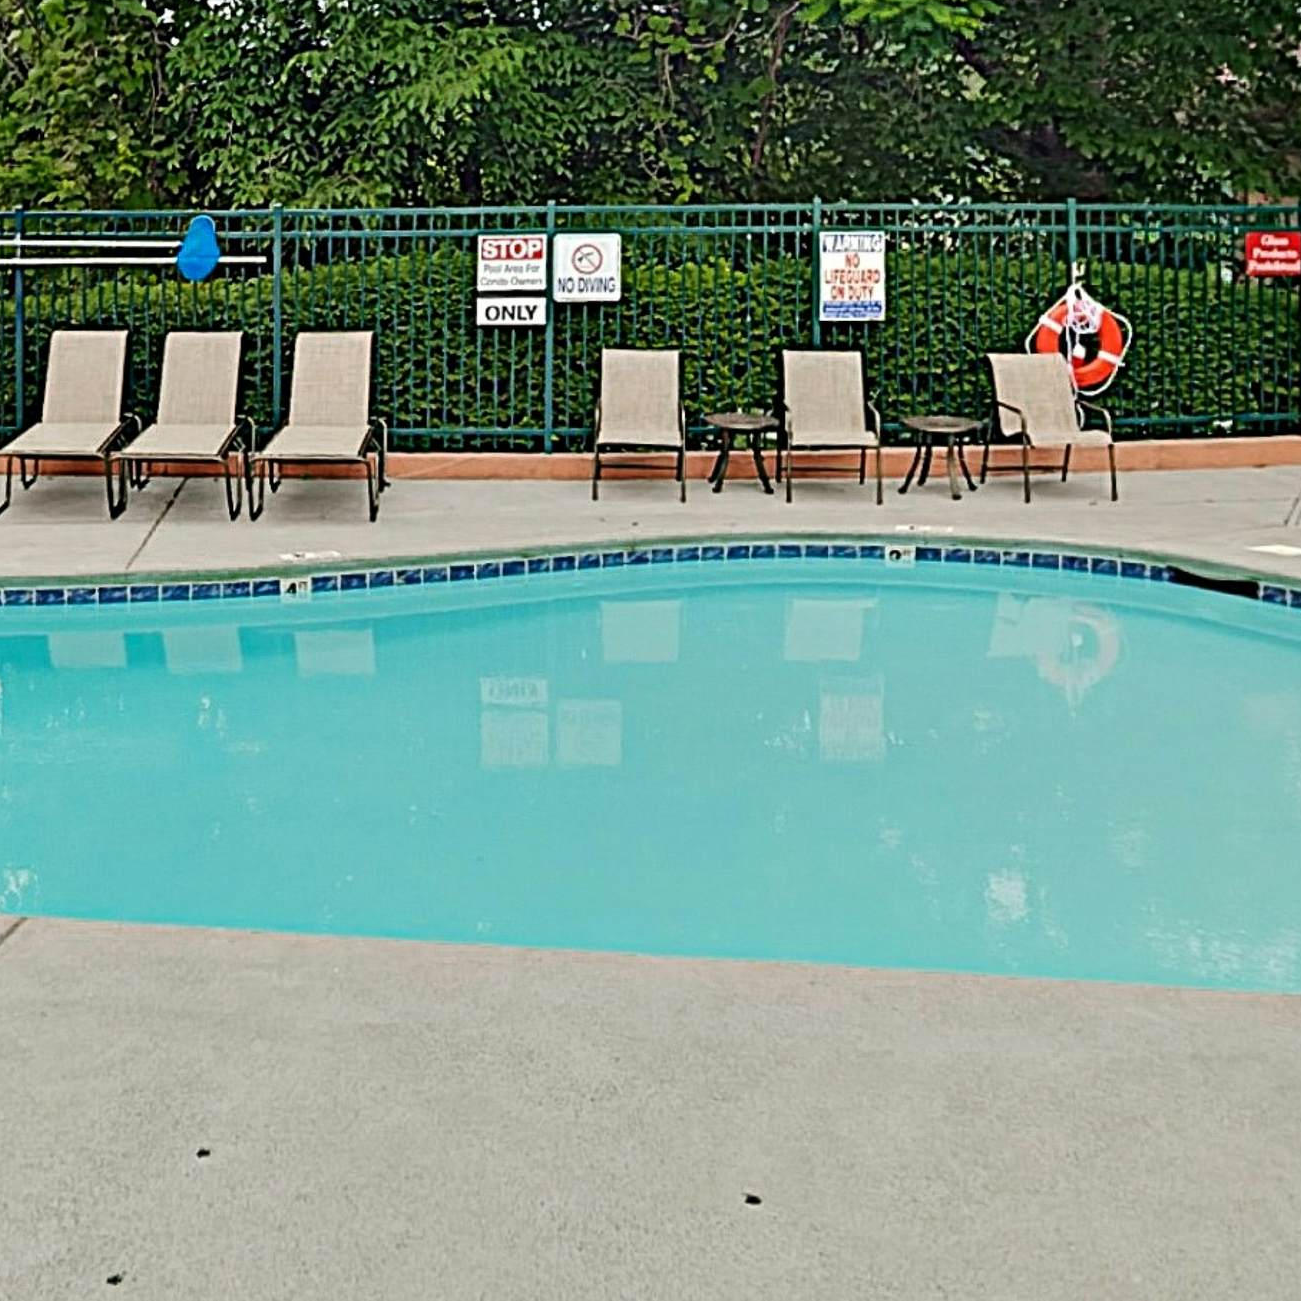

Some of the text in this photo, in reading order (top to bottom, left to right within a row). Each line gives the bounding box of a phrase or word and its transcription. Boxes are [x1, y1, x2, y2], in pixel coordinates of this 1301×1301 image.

[482, 239, 542, 259] STOP
[845, 252, 860, 268] NO
[824, 268, 881, 284] LIFEGUARD
[558, 277, 616, 293] NO DIVING
[831, 285, 874, 300] ON DUTY
[485, 304, 538, 321] ONLY
